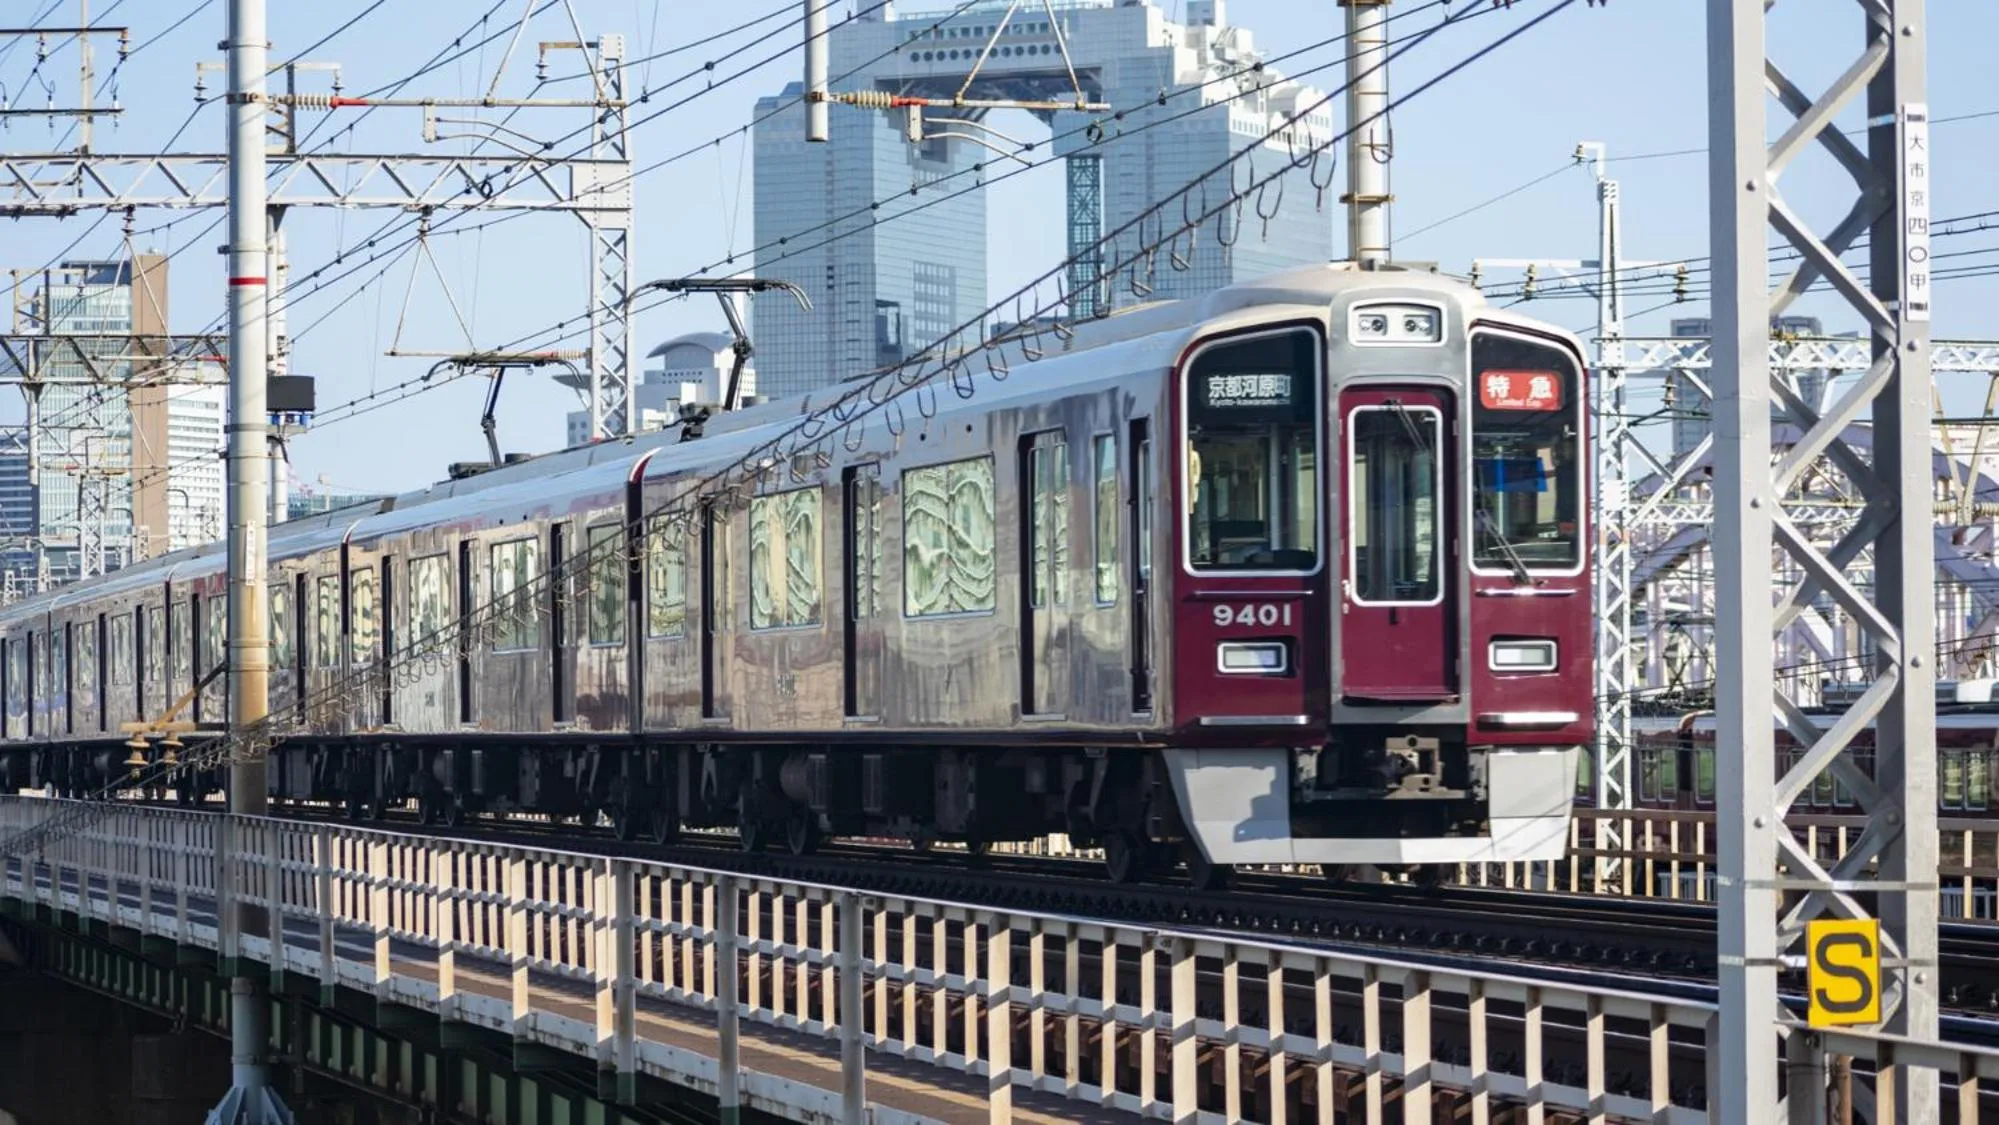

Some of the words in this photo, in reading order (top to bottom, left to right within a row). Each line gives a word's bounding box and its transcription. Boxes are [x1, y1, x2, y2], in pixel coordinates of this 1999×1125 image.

[1208, 375, 1290, 398] 京都河原町
[1487, 375, 1553, 399] 特急
[1213, 604, 1291, 626] 9401
[1816, 933, 1872, 1013] S
